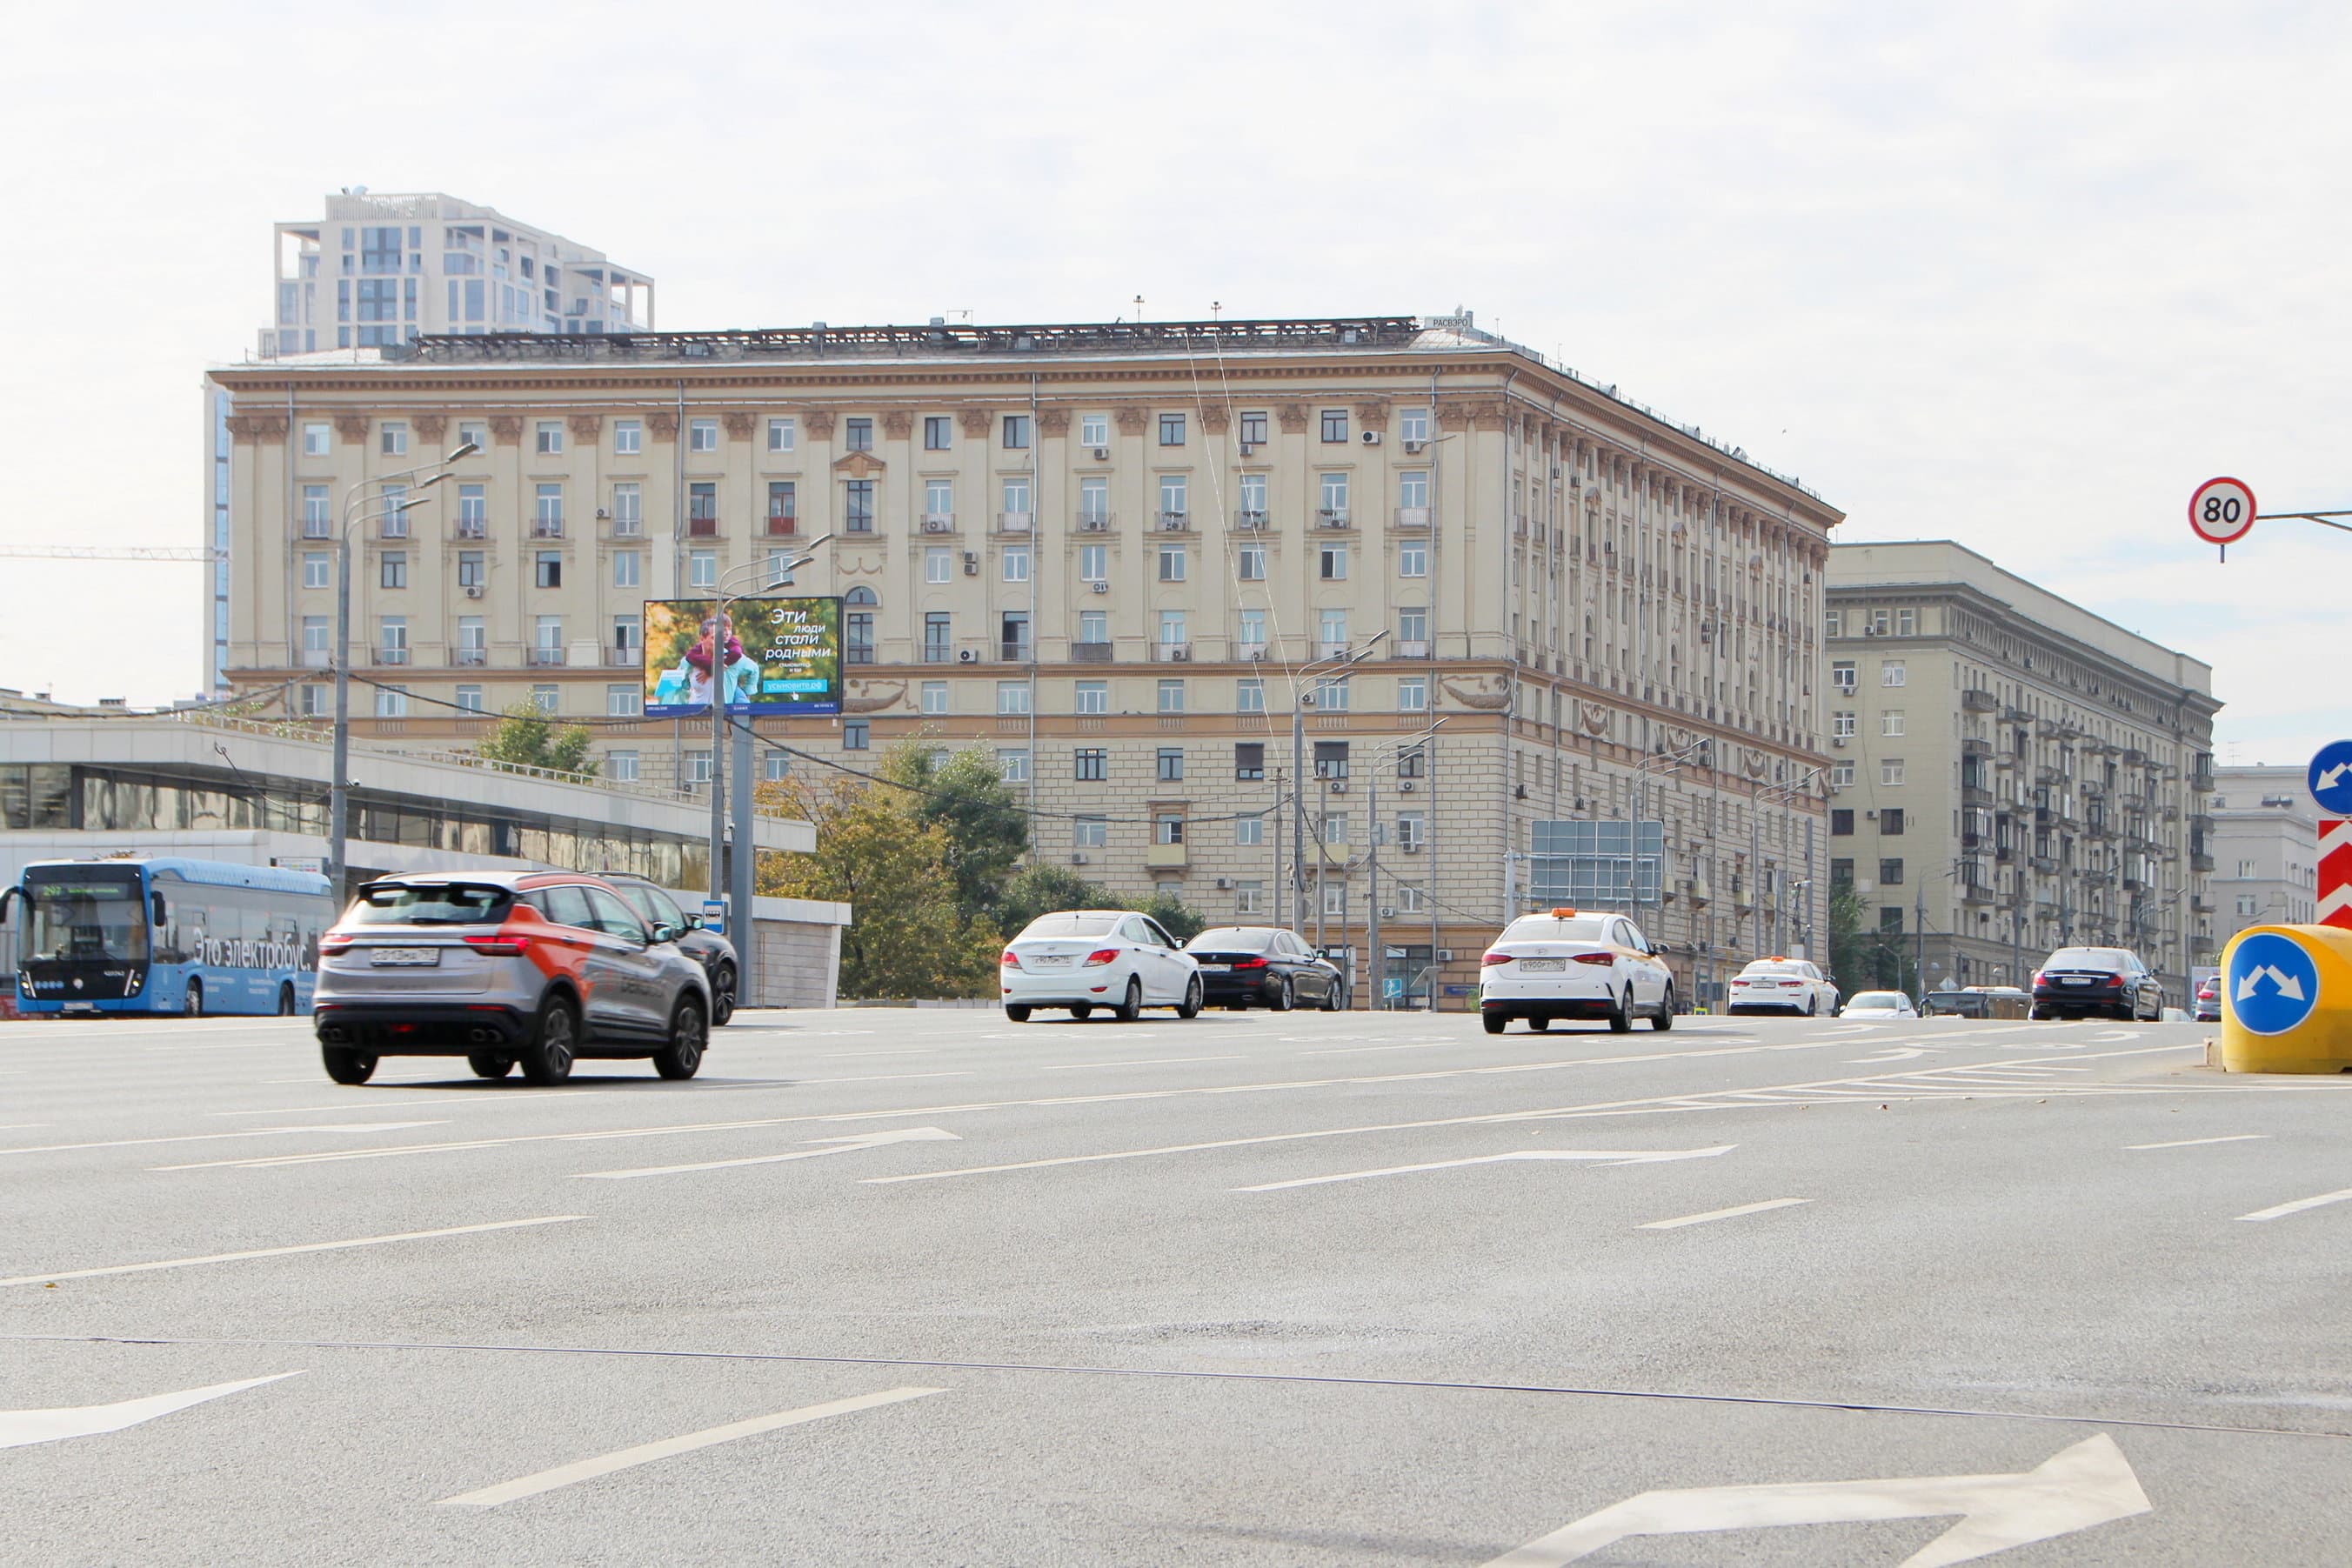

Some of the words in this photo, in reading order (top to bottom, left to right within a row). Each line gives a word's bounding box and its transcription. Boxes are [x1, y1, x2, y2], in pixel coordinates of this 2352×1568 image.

[2203, 497, 2241, 524] 80
[771, 608, 807, 624] Эти
[793, 624, 826, 634] люди
[775, 634, 819, 645] стали
[765, 647, 832, 661] родными
[193, 927, 222, 964] Это
[224, 932, 311, 979] электробус.
